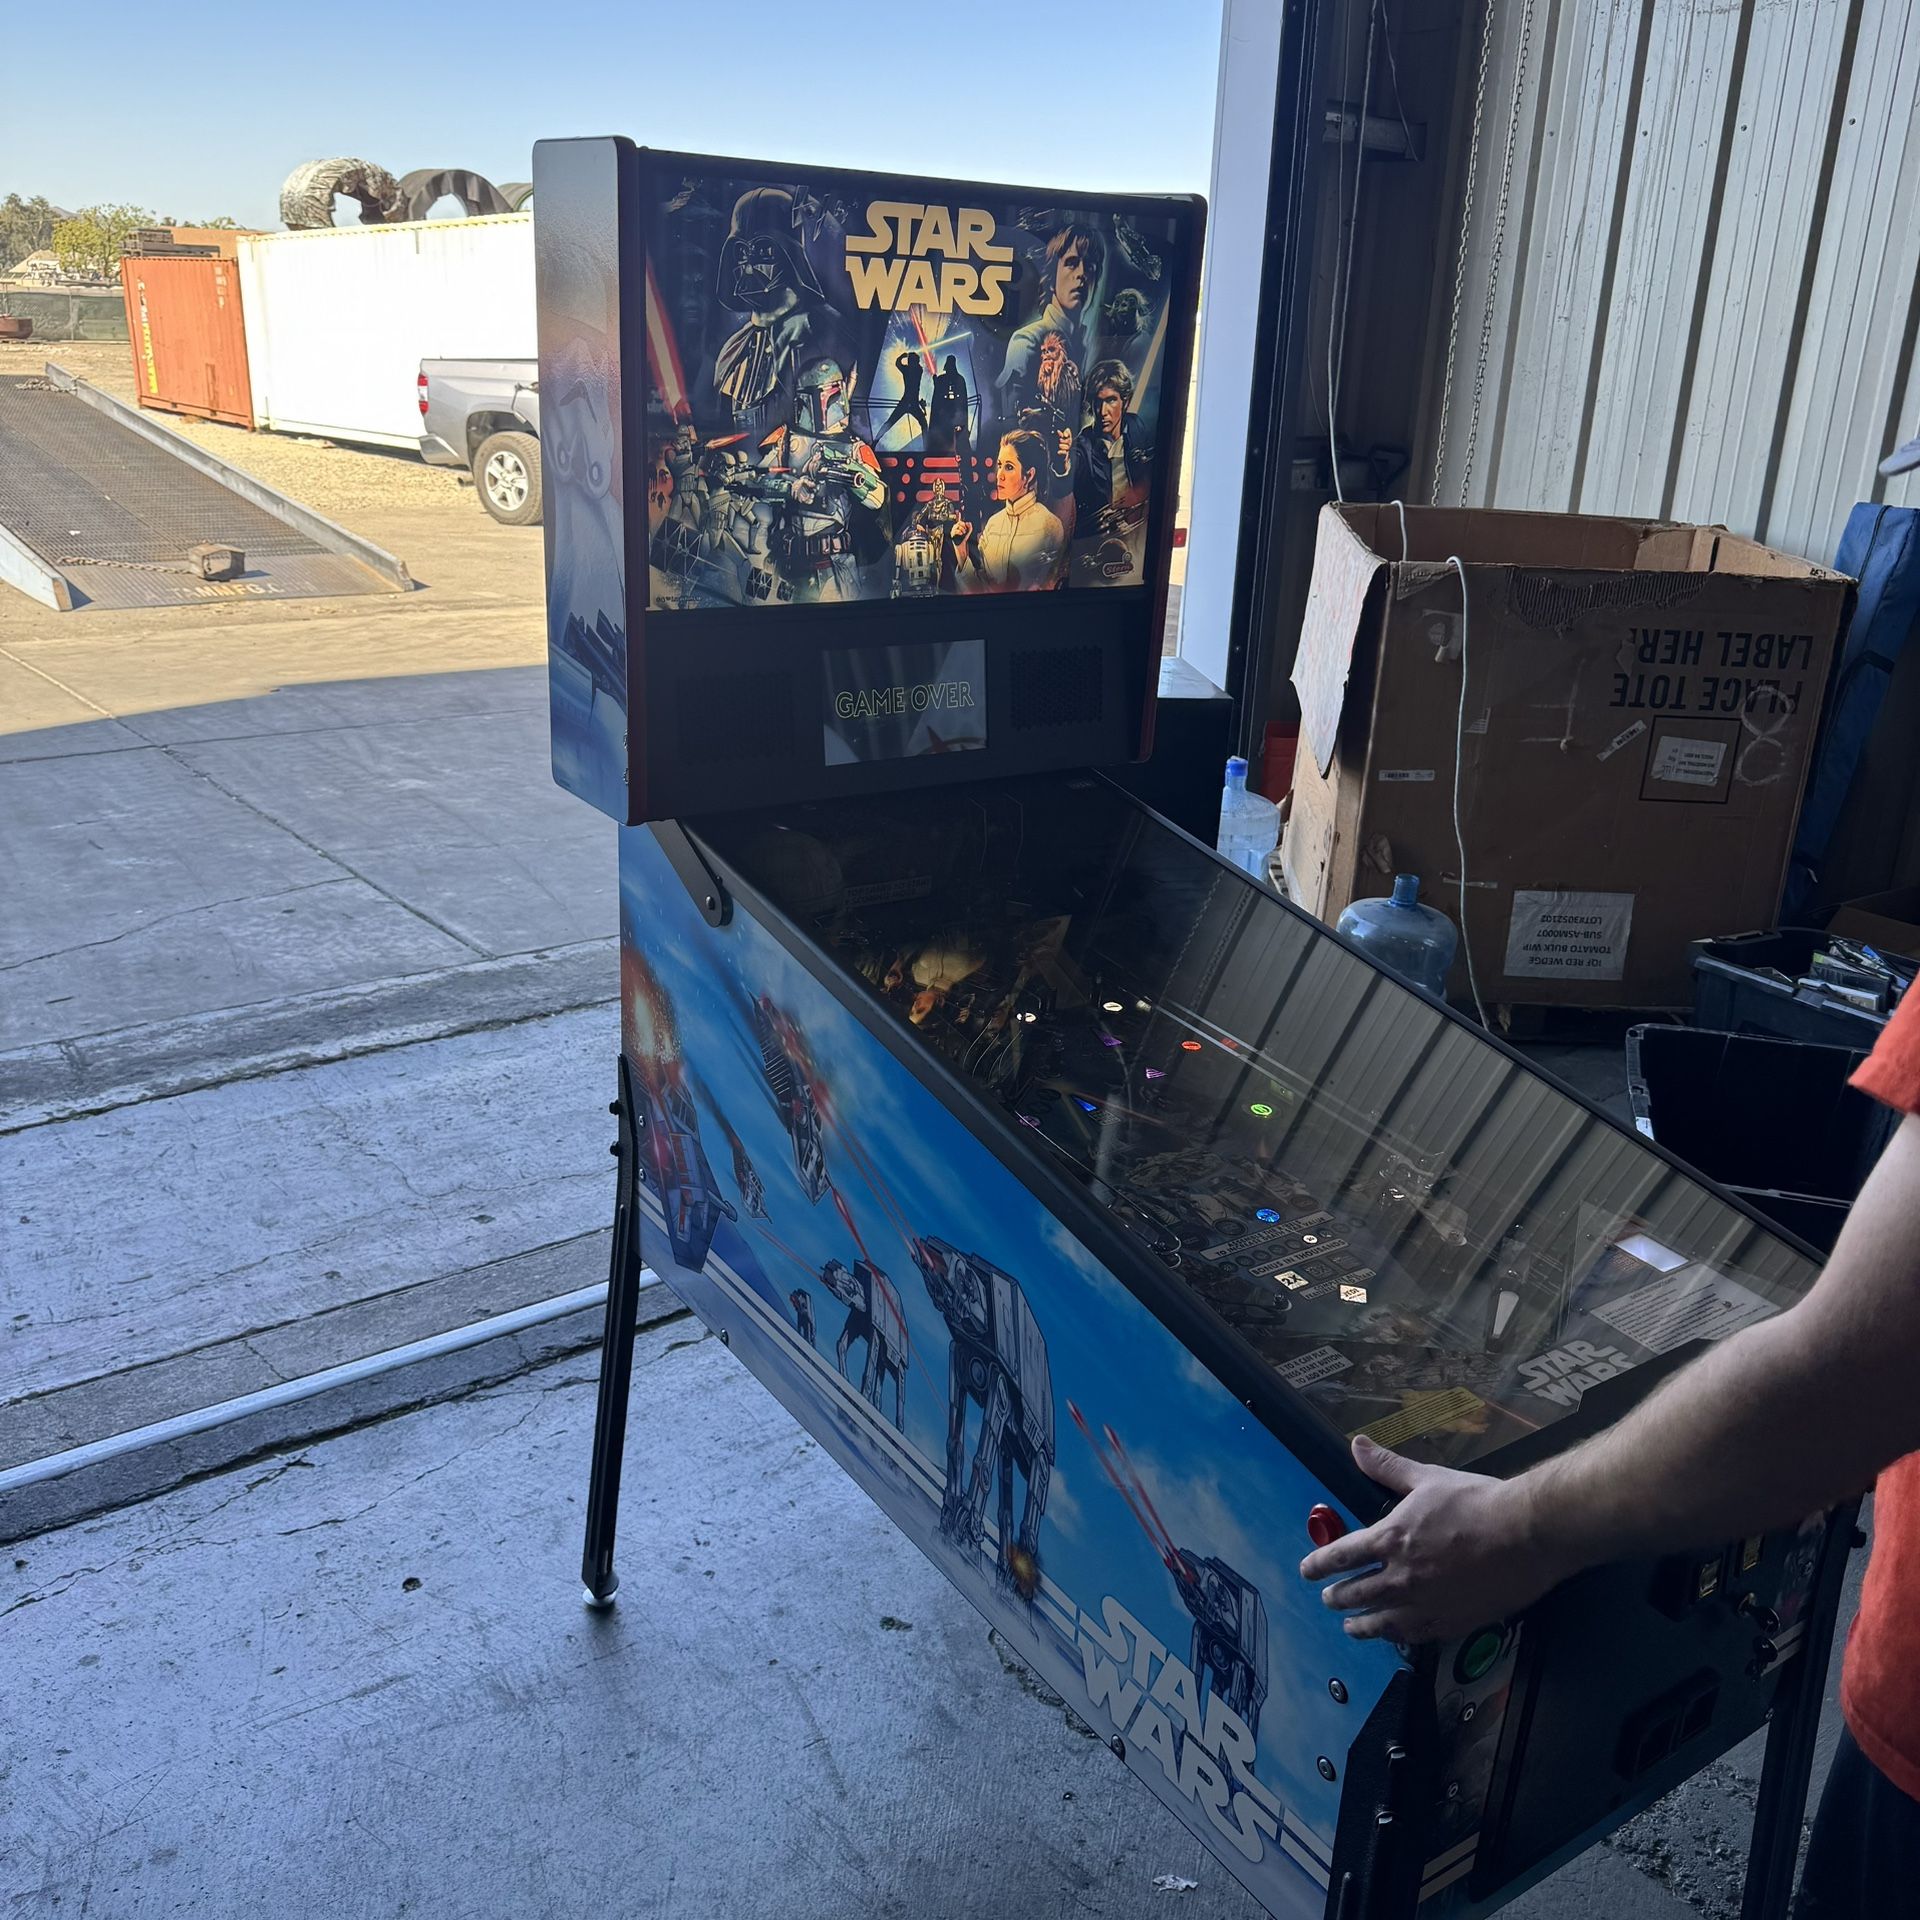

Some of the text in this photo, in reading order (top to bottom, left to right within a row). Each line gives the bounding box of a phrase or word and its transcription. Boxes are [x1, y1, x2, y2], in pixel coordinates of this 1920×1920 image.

[846, 200, 1014, 263] STAR
[845, 255, 1013, 316] WARS
[1716, 631, 1814, 670] LABEL
[835, 681, 975, 719] GAME OVER
[1609, 673, 1803, 715] PLACE TOTE
[1536, 930, 1602, 940] SUB-ASM0007
[1543, 944, 1568, 953] BULK
[1569, 944, 1612, 954] TOMATO
[1528, 956, 1564, 966] WEDGE
[1565, 958, 1584, 966] RED
[1251, 1261, 1283, 1275] BONUS
[1283, 1257, 1295, 1266] IN
[1294, 1239, 1345, 1261] THOUSANDS
[1281, 1274, 1303, 1288] 2X
[1517, 1339, 1619, 1391] STAR
[1079, 1595, 1282, 1818] STAR
[1077, 1635, 1278, 1863] WARS
